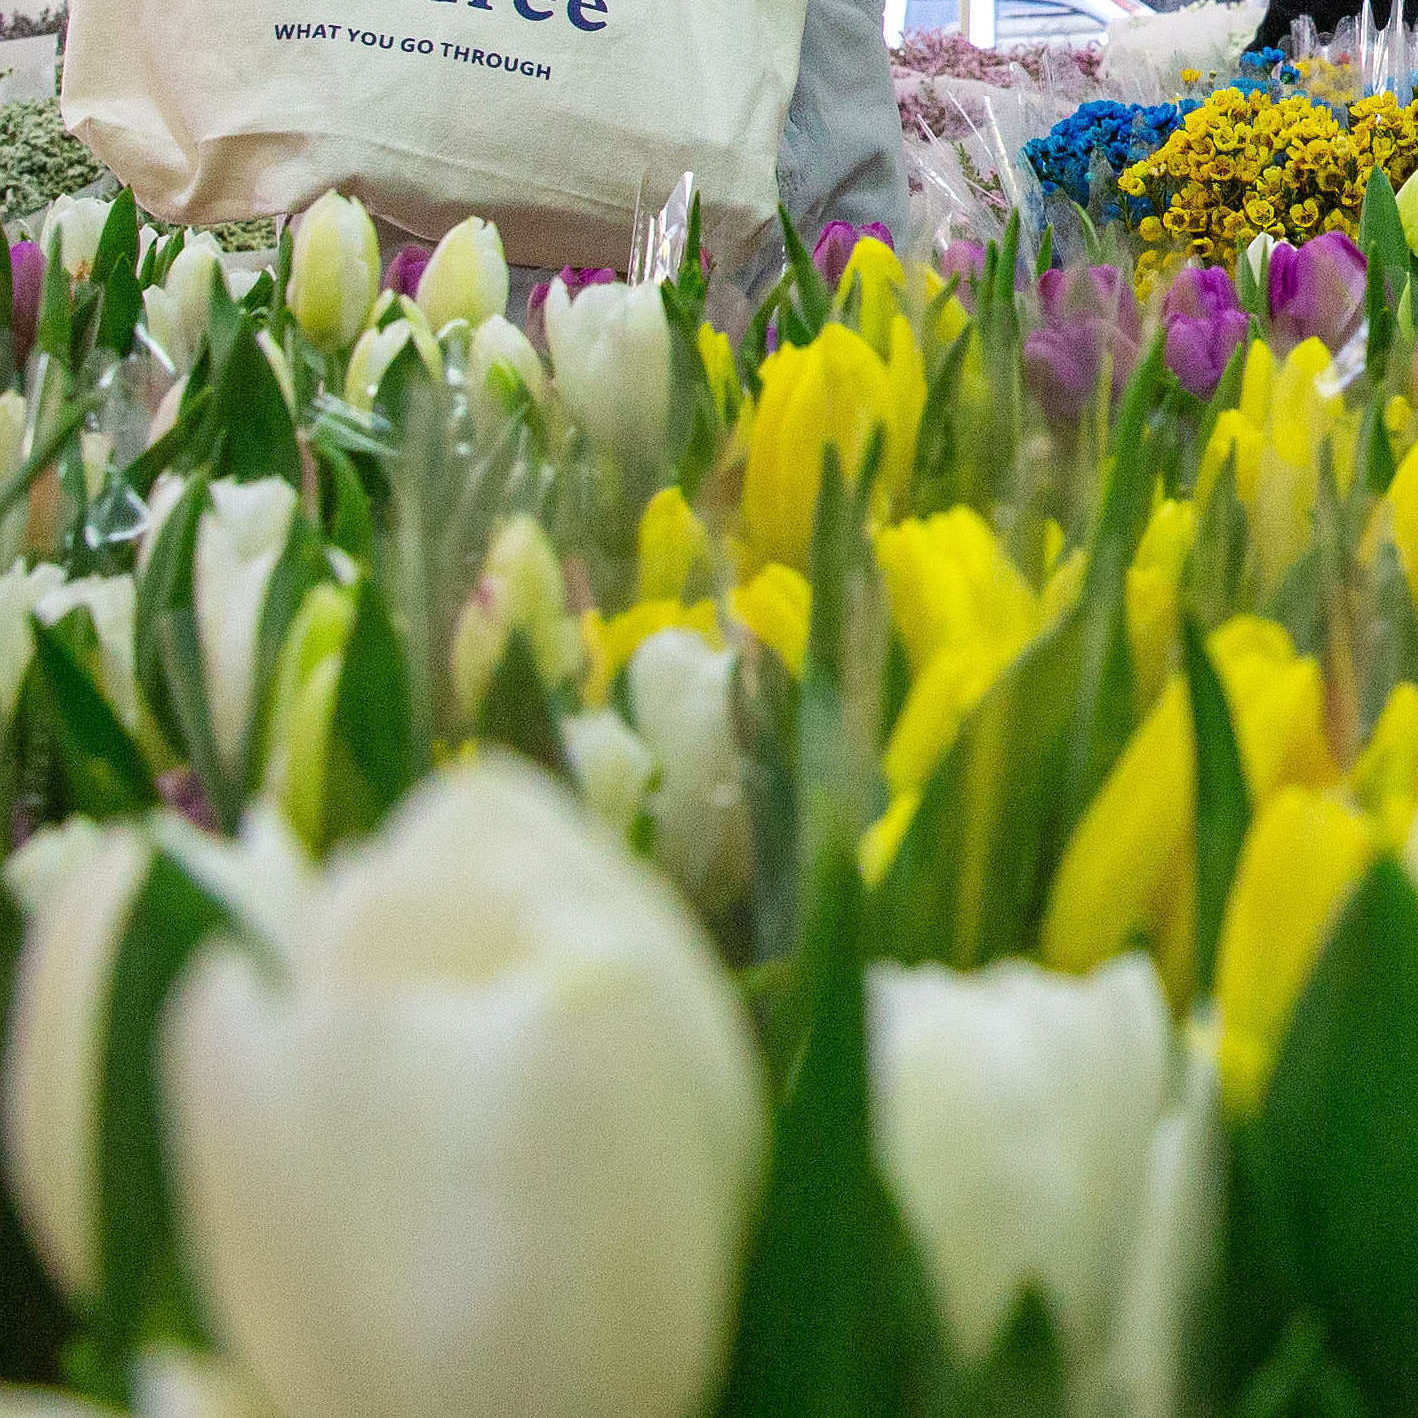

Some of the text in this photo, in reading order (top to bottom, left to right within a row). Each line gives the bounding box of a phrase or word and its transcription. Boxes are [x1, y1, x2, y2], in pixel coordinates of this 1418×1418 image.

[274, 22, 552, 81] WHAT YOU GO THROUGH
